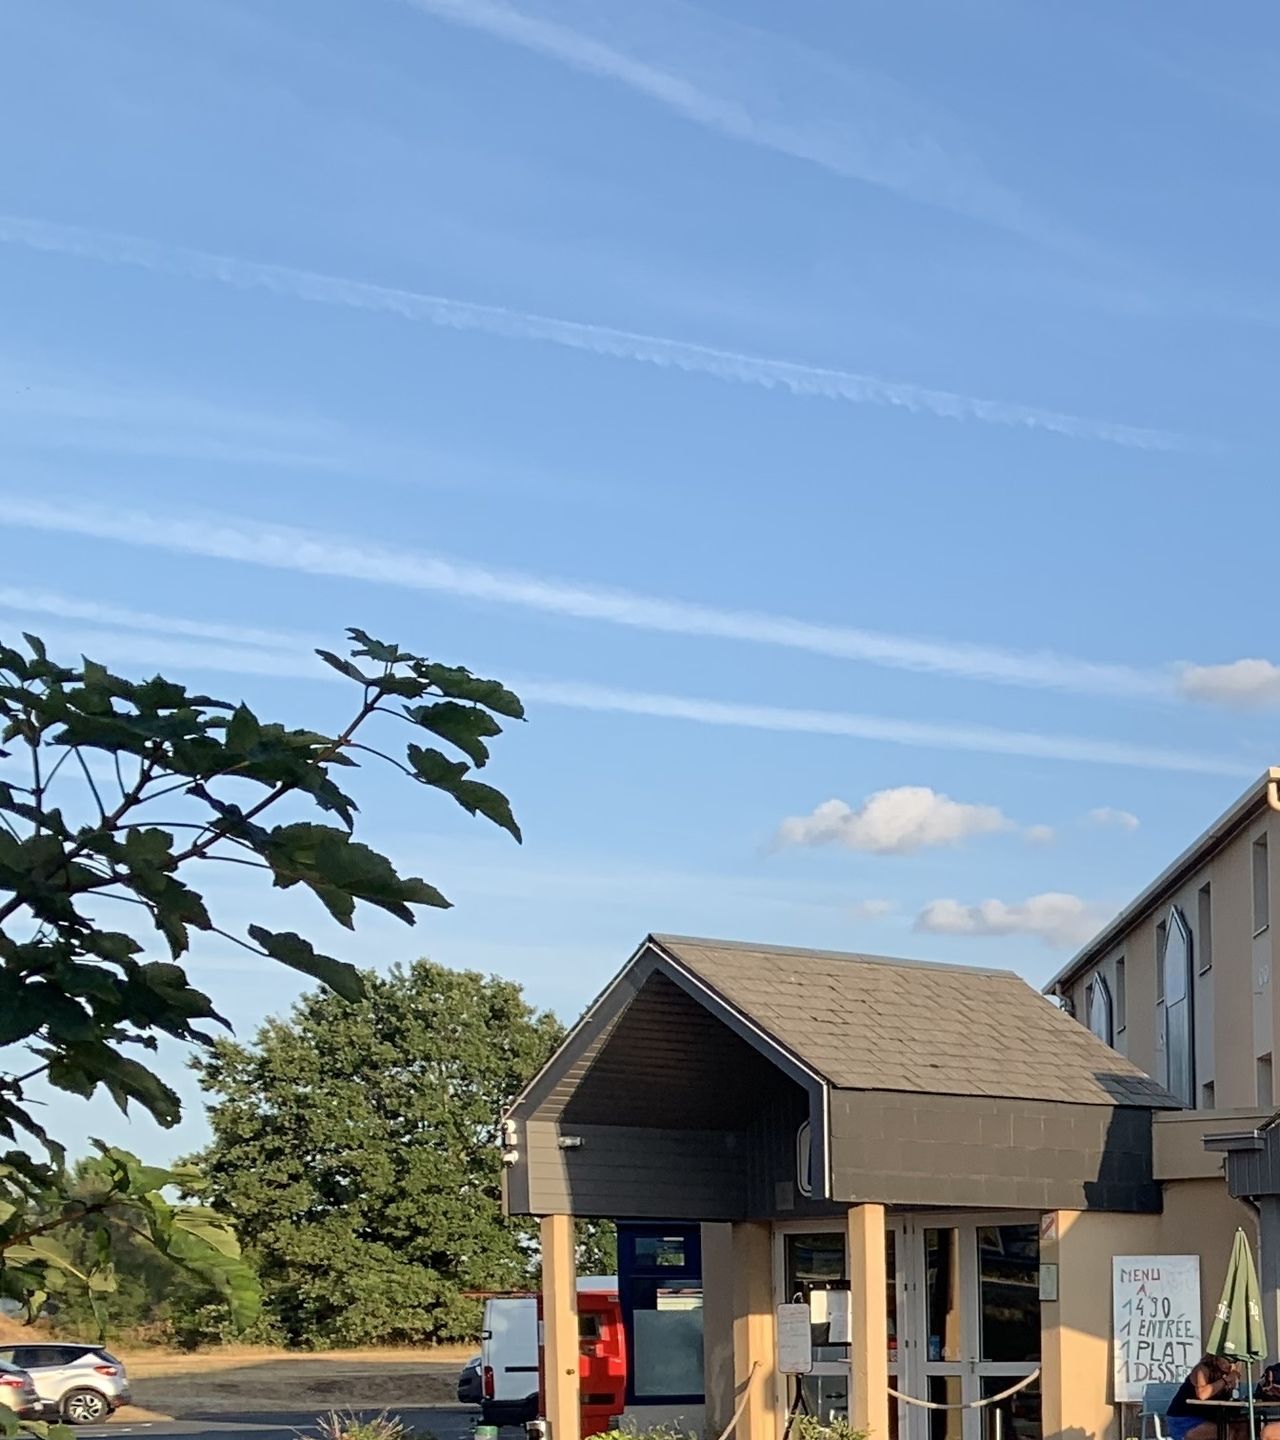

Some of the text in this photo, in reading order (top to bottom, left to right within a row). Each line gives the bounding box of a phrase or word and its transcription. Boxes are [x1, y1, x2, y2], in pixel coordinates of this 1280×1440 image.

[1121, 1269, 1160, 1282] MENU
[1139, 1313, 1194, 1338] ENTRÉE
[1136, 1341, 1194, 1365] PLAT
